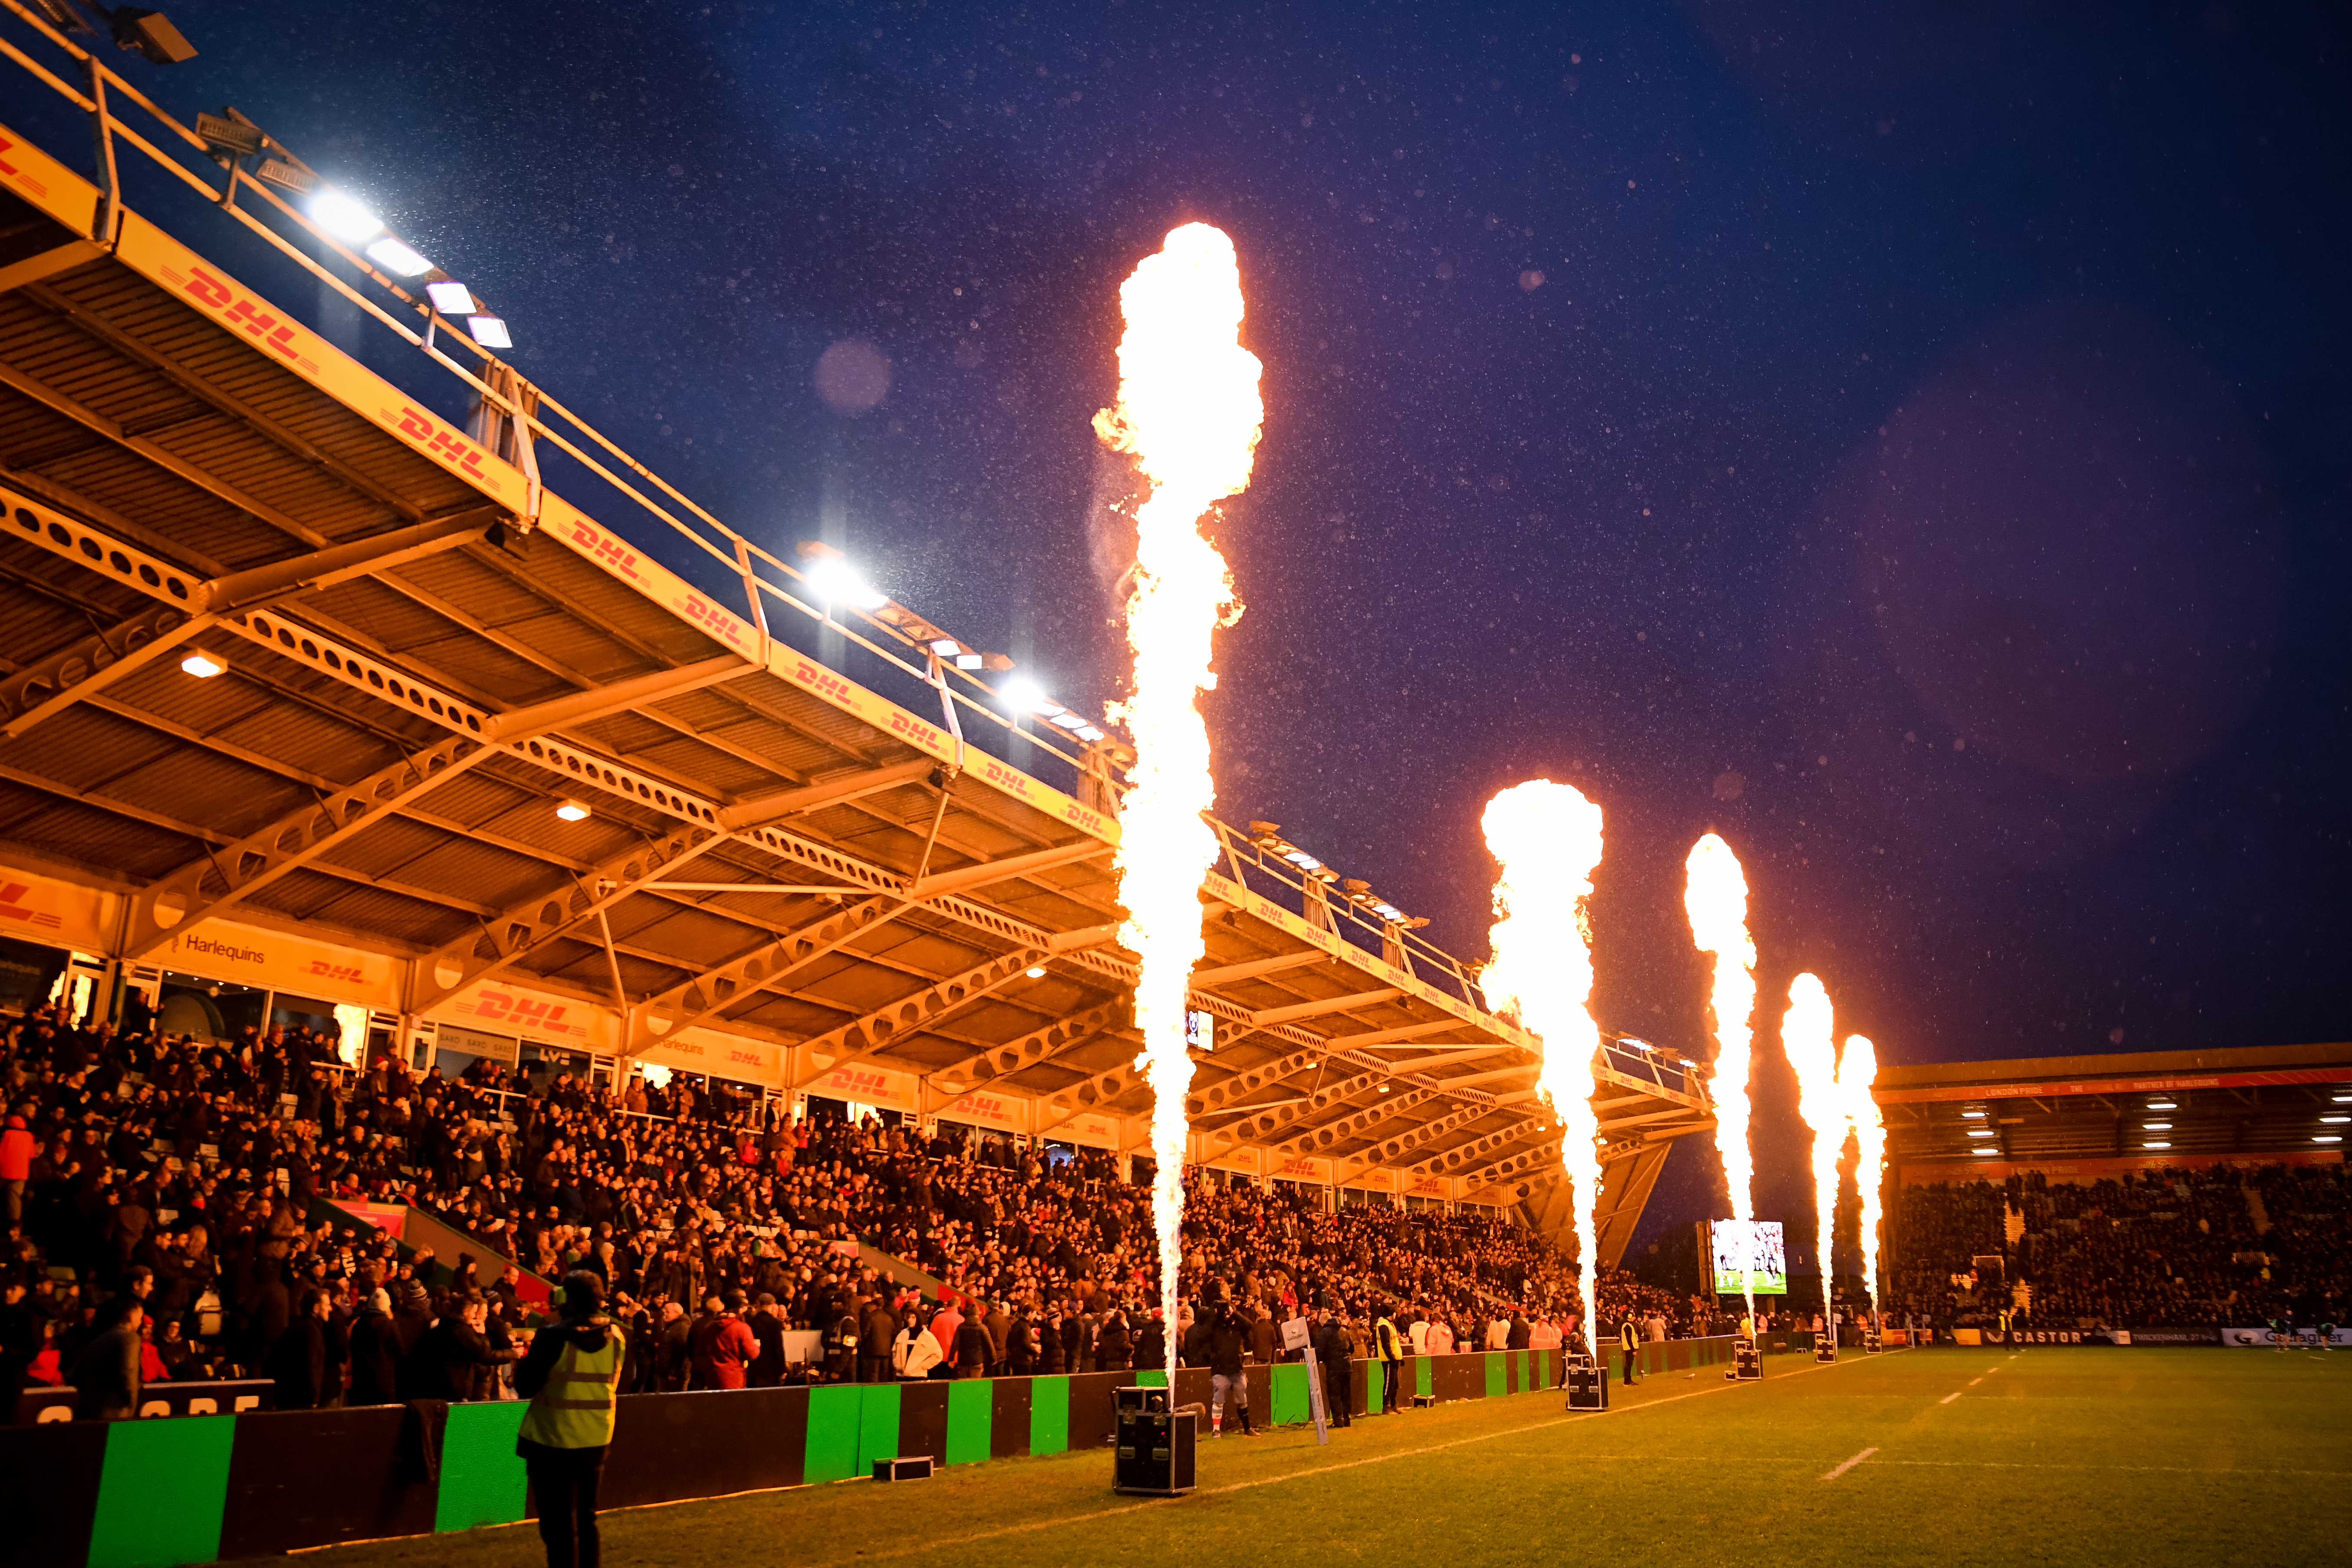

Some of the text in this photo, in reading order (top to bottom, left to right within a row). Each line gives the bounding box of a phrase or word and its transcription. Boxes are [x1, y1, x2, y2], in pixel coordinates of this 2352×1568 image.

[184, 267, 299, 360] DHL
[398, 407, 485, 480] DHL
[572, 519, 638, 579] DHL
[684, 594, 741, 645] DHL
[795, 661, 852, 706] DHL
[890, 712, 940, 751] DHL
[986, 762, 1028, 797] DHL
[1066, 803, 1102, 834] DHL
[1260, 902, 1285, 925] DHL
[1306, 926, 1328, 947] DHL
[186, 934, 265, 963] Harlequins
[1352, 950, 1371, 969] DHL
[309, 960, 365, 983] DHL
[1388, 969, 1406, 987] DHL
[1424, 987, 1440, 1003] DHL
[473, 989, 571, 1033] DHL
[1454, 1002, 1468, 1018] DHL
[730, 1050, 762, 1066] DHL
[830, 1067, 889, 1097] DHL
[1620, 1075, 1633, 1086] DHL
[1644, 1083, 1657, 1093] DHL
[1985, 1087, 2043, 1097] LONDON PRIDE
[1669, 1091, 1681, 1101] DHL
[957, 1095, 1004, 1121] DHL
[1089, 1124, 1106, 1134] DHL
[1238, 1154, 1251, 1163] DHL
[1374, 1175, 1388, 1183] DHL
